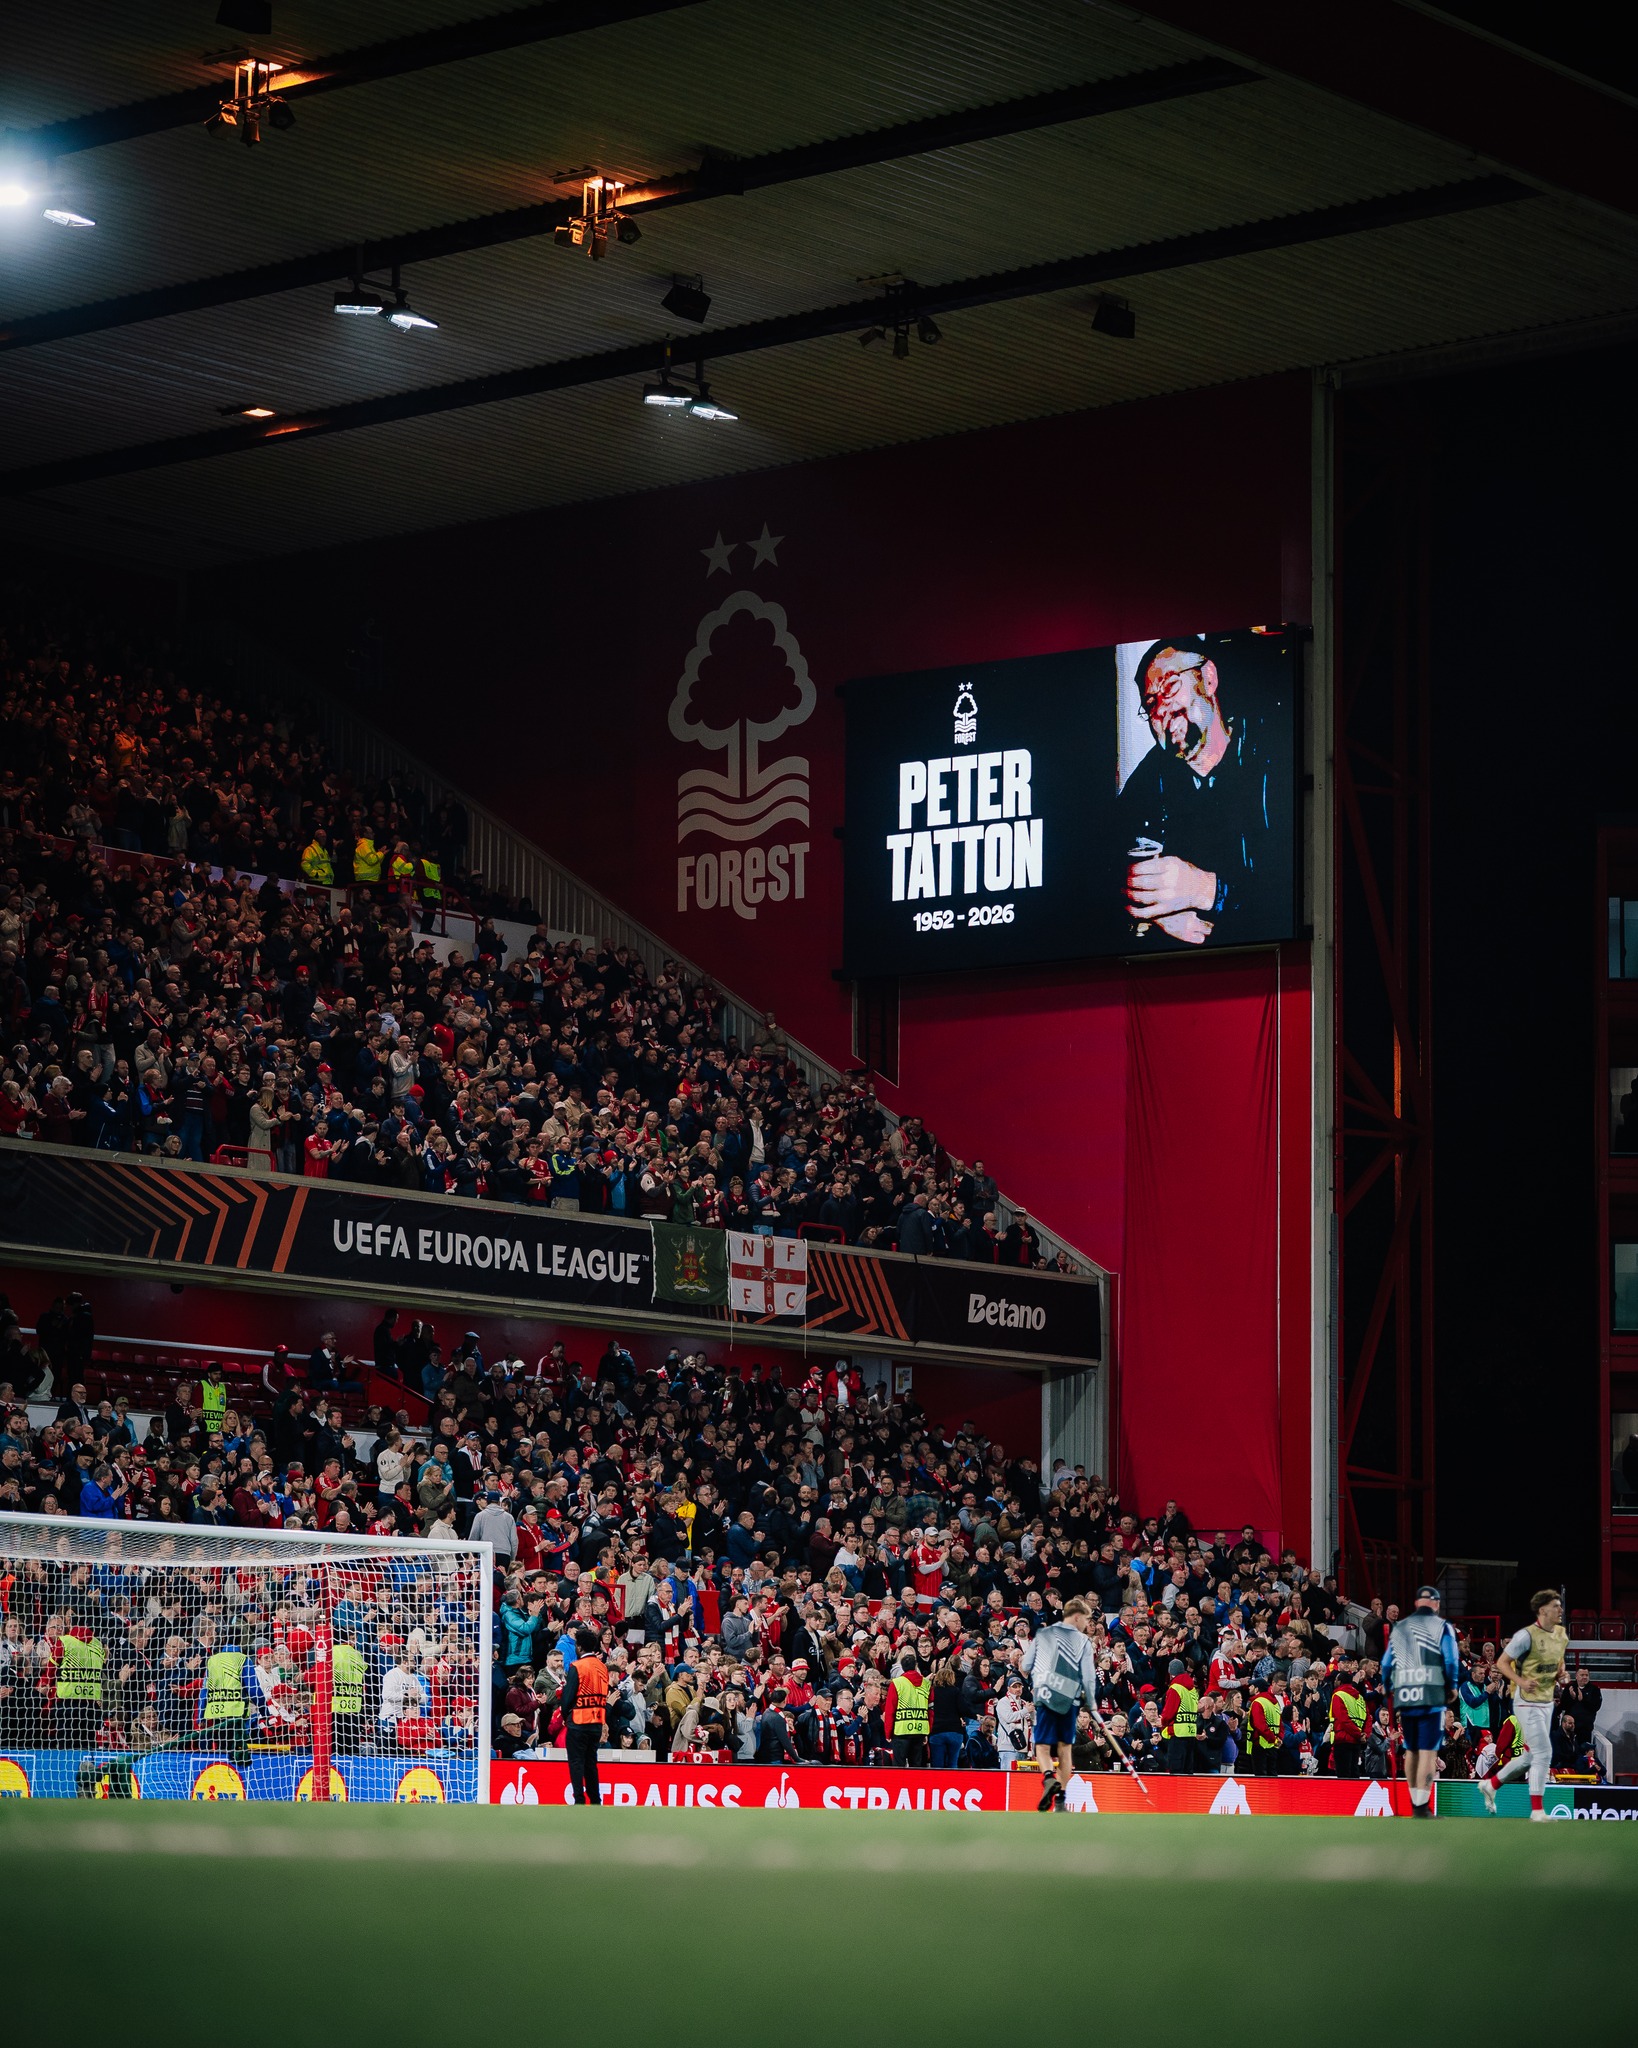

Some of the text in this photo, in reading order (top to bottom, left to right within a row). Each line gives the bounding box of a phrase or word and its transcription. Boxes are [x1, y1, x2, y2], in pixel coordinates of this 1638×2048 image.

[899, 749, 1032, 830] PETER
[886, 818, 1043, 901] TATTON
[913, 909, 955, 932] 1952
[968, 903, 1015, 927] 2026
[333, 1219, 411, 1259] UEFA
[418, 1228, 529, 1273] EUROPA
[742, 1239, 796, 1262] N F
[743, 1288, 796, 1308] F C
[968, 1293, 1046, 1331] Betano
[1398, 1686, 1424, 1702] 001
